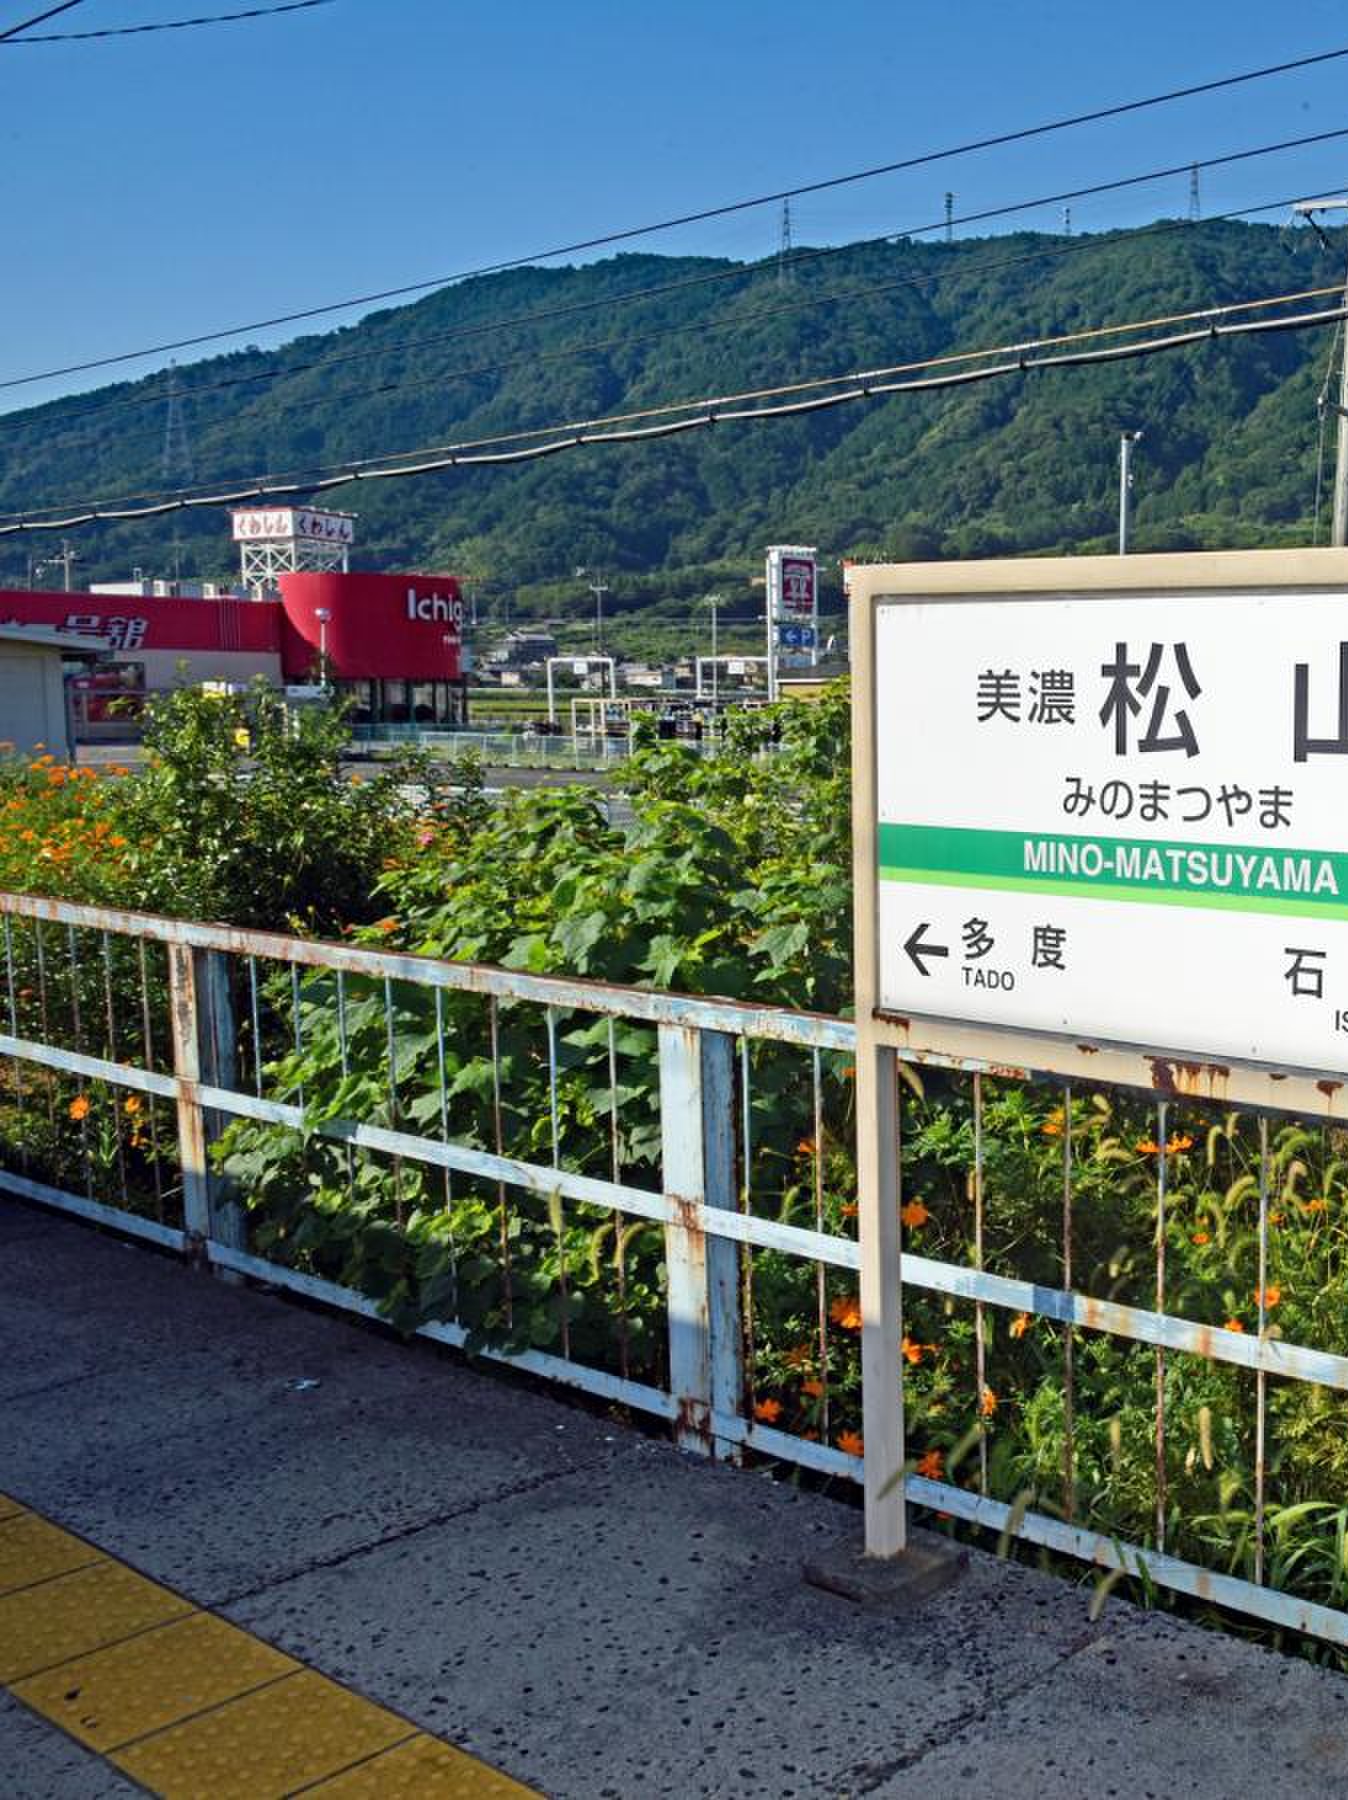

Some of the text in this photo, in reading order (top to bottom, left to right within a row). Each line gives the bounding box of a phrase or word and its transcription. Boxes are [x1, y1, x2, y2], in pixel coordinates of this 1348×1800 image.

[977, 670, 1076, 725] 美濃
[1063, 776, 1294, 829] みのまつやま
[1023, 840, 1340, 896] MINO-MATSUYAMA
[961, 917, 1067, 972] 多度
[961, 966, 1015, 991] TADO
